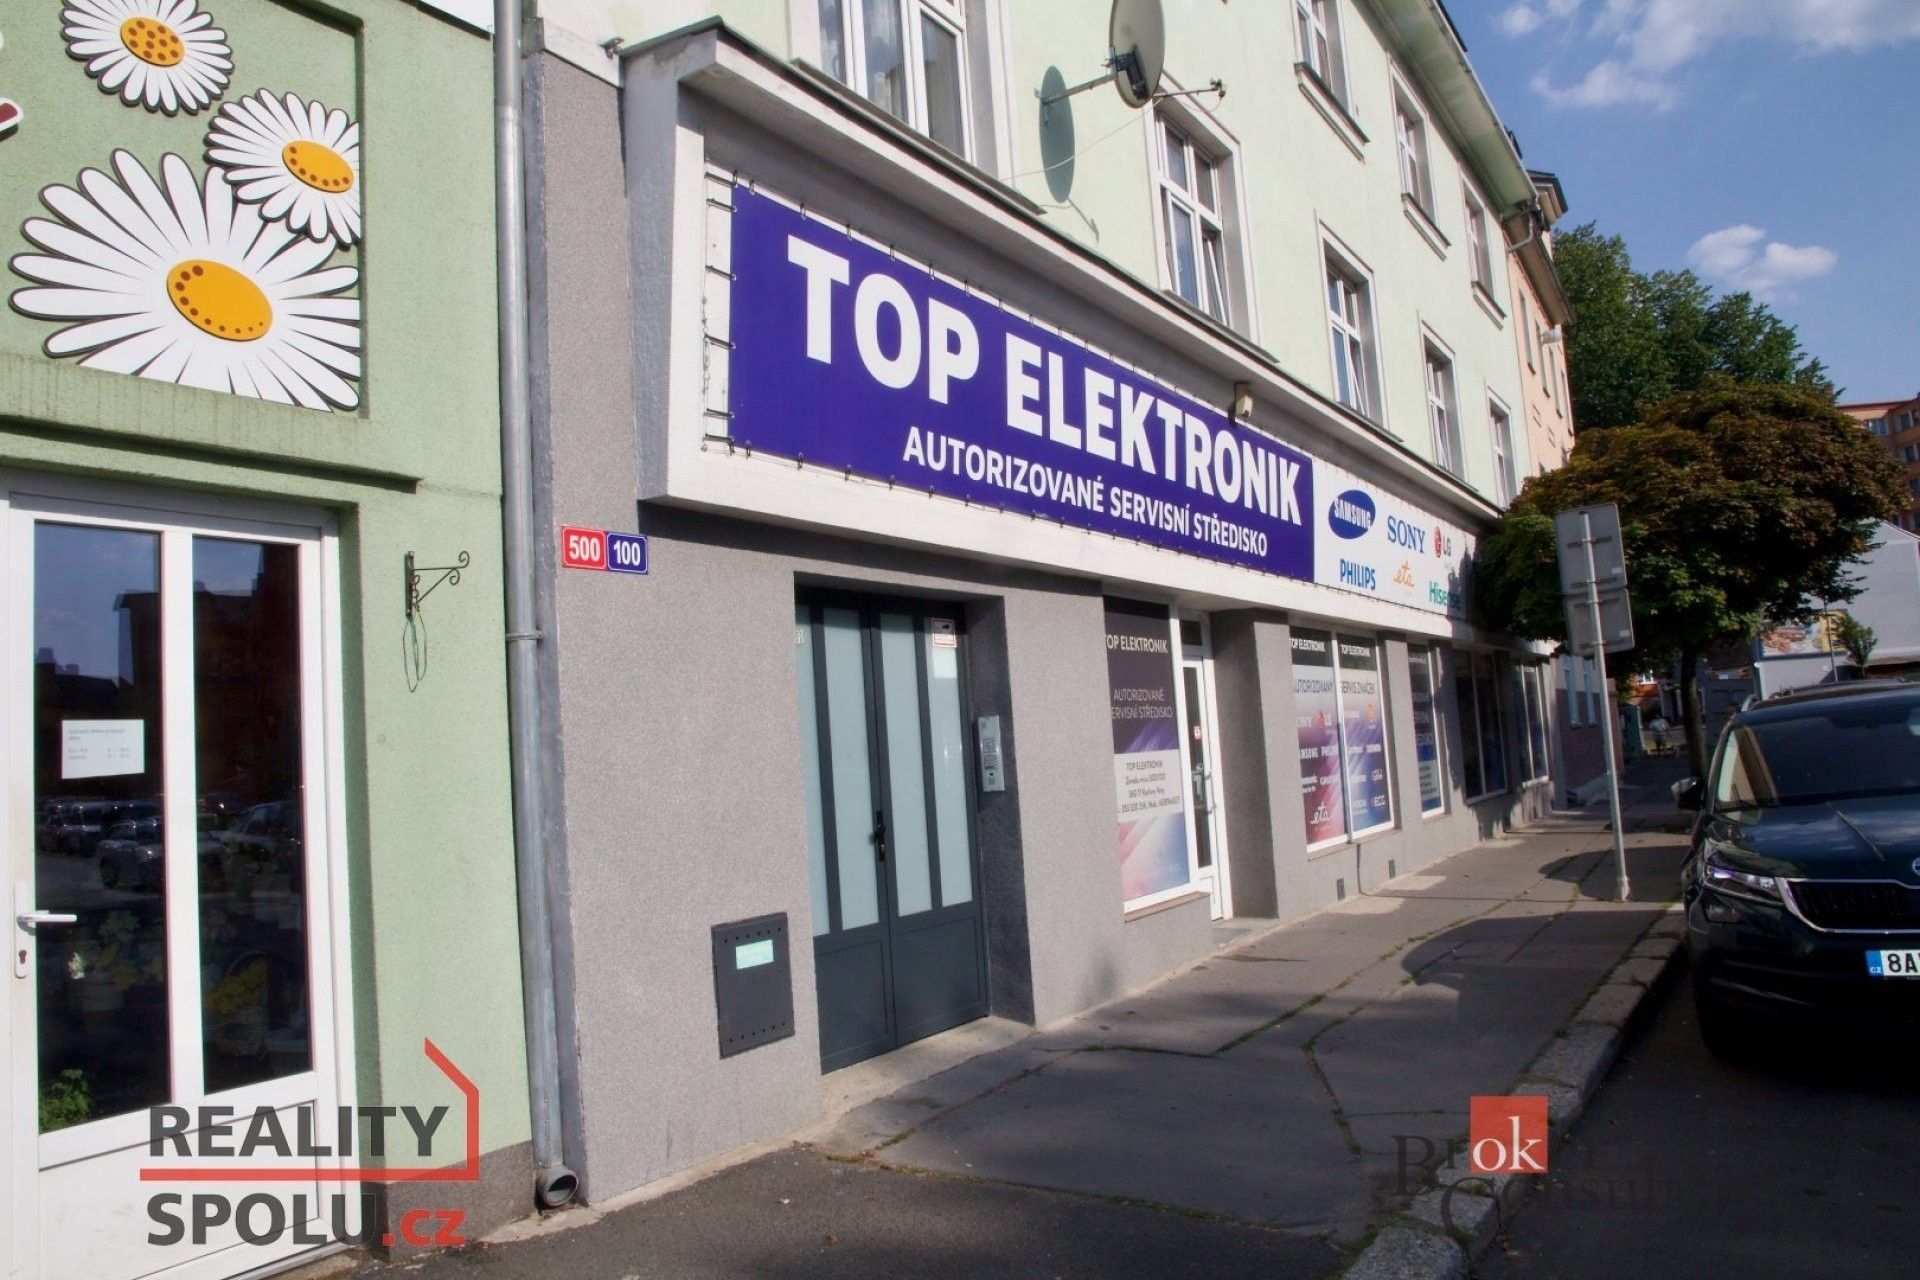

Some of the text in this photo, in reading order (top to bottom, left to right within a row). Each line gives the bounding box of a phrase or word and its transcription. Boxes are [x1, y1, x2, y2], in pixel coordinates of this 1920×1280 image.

[788, 234, 1302, 526] TOP ELEKTRONIK
[903, 426, 1268, 557] AUTORIZOVANÉ SERVISNÍ STŘEDISKO
[1333, 498, 1372, 529] SAMSUNG
[569, 534, 601, 562] 500
[1387, 515, 1426, 554] SONY
[613, 540, 641, 566] 100
[1339, 558, 1376, 592] PHILIPS
[1105, 633, 1168, 653] OP ELEKTRONIK
[1111, 704, 1138, 719] ERVISNÍ
[1887, 953, 1920, 973] 8A
